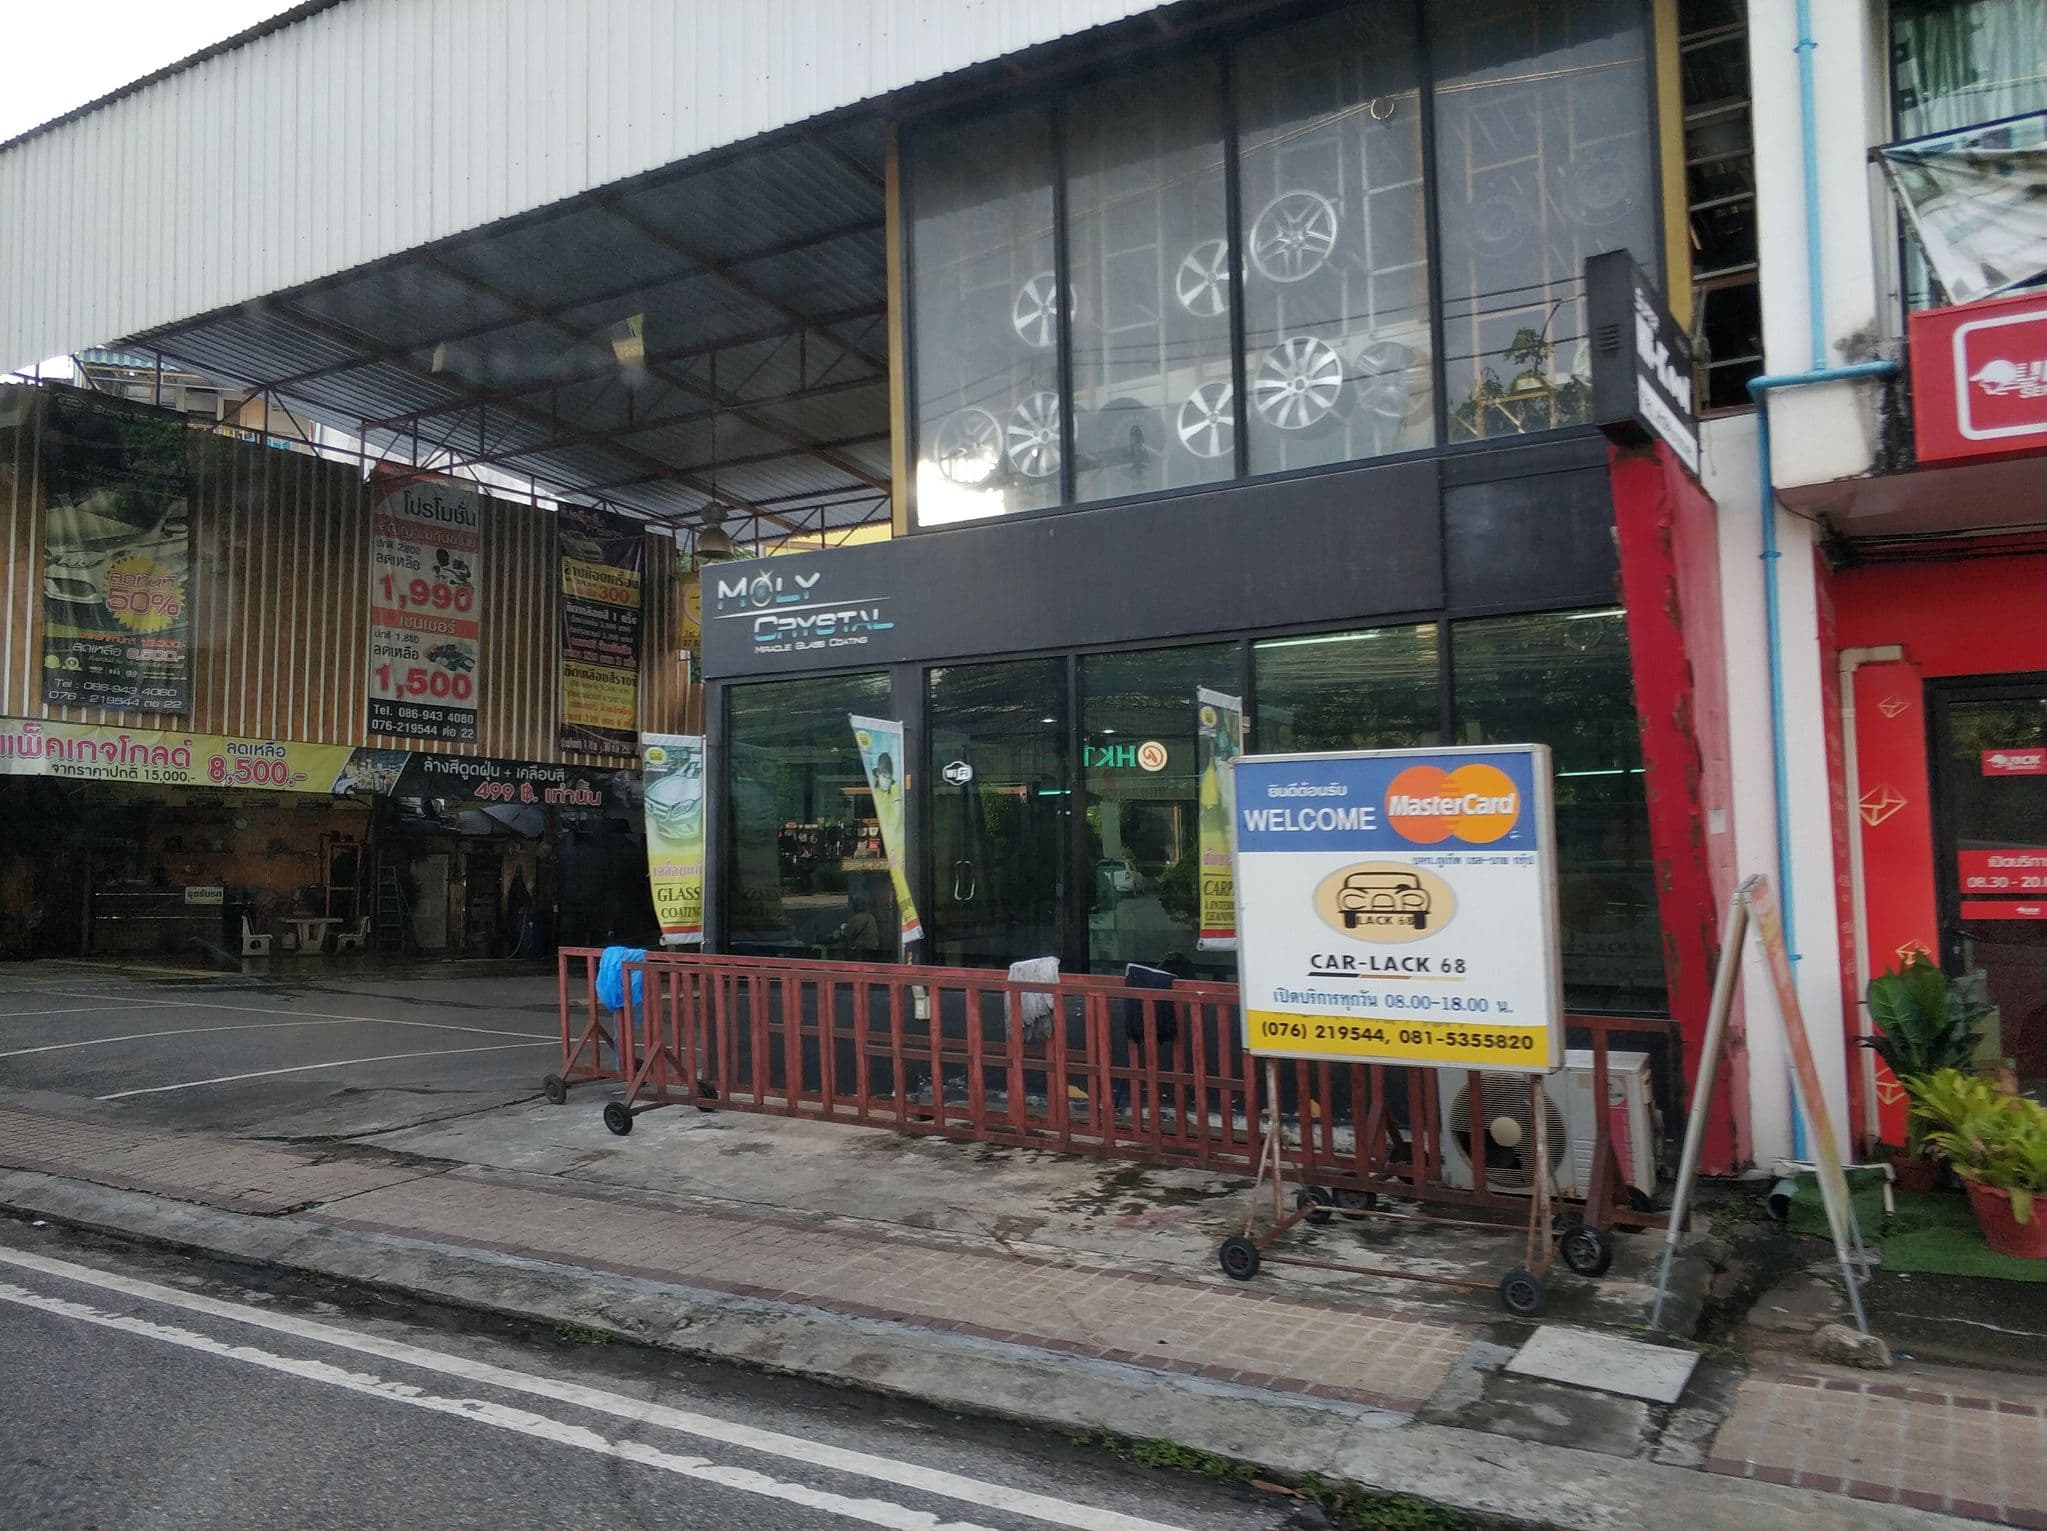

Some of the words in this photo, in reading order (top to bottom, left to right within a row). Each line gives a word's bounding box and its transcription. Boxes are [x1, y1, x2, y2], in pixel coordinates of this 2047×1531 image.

[403, 489, 477, 527] โปรโมชั่น
[375, 552, 421, 571] ลดเหลือ
[109, 571, 177, 589] ลดทันที
[378, 572, 474, 613] 1,990
[599, 585, 630, 604] 300
[717, 571, 821, 610] MOLY
[106, 586, 182, 617] 50%
[753, 608, 895, 642] CRYSTAL
[373, 644, 420, 661] ลดเหลือ
[54, 678, 73, 688] Tel
[374, 662, 473, 700] 1,500
[89, 694, 140, 707] 219544
[162, 700, 183, 710] 22
[373, 704, 393, 716] Tel.
[398, 707, 443, 721] 086-943
[447, 714, 474, 725] 4080
[371, 719, 438, 736] 076-219544
[442, 725, 457, 737] ต่อ
[460, 728, 474, 739] 22
[226, 741, 287, 759] ลดเหลือ
[52, 764, 139, 780] จากราคาปกติ
[423, 756, 500, 781] ล้างสีดูดฝุ่น
[516, 765, 565, 782] เคลือบสี
[474, 781, 515, 801] 499
[544, 779, 602, 806] เท่านั้น
[1267, 781, 1348, 798] ยินดีต้อนรับ
[1388, 793, 1517, 817] MasterCard
[1243, 806, 1377, 832] WELCOME
[657, 886, 701, 903] GLASS
[661, 905, 702, 920] COATIN
[1310, 954, 1430, 973] CAR-LACK
[1440, 957, 1466, 974] 68
[1273, 987, 1379, 1011] เปิดบริการทุกวัน
[1384, 993, 1489, 1013] 08.00-18.00
[1497, 1001, 1514, 1014] น.
[1262, 1020, 1307, 1040] (076)
[1316, 1025, 1391, 1046] 219544,
[1399, 1029, 1534, 1050] 081-5355820
